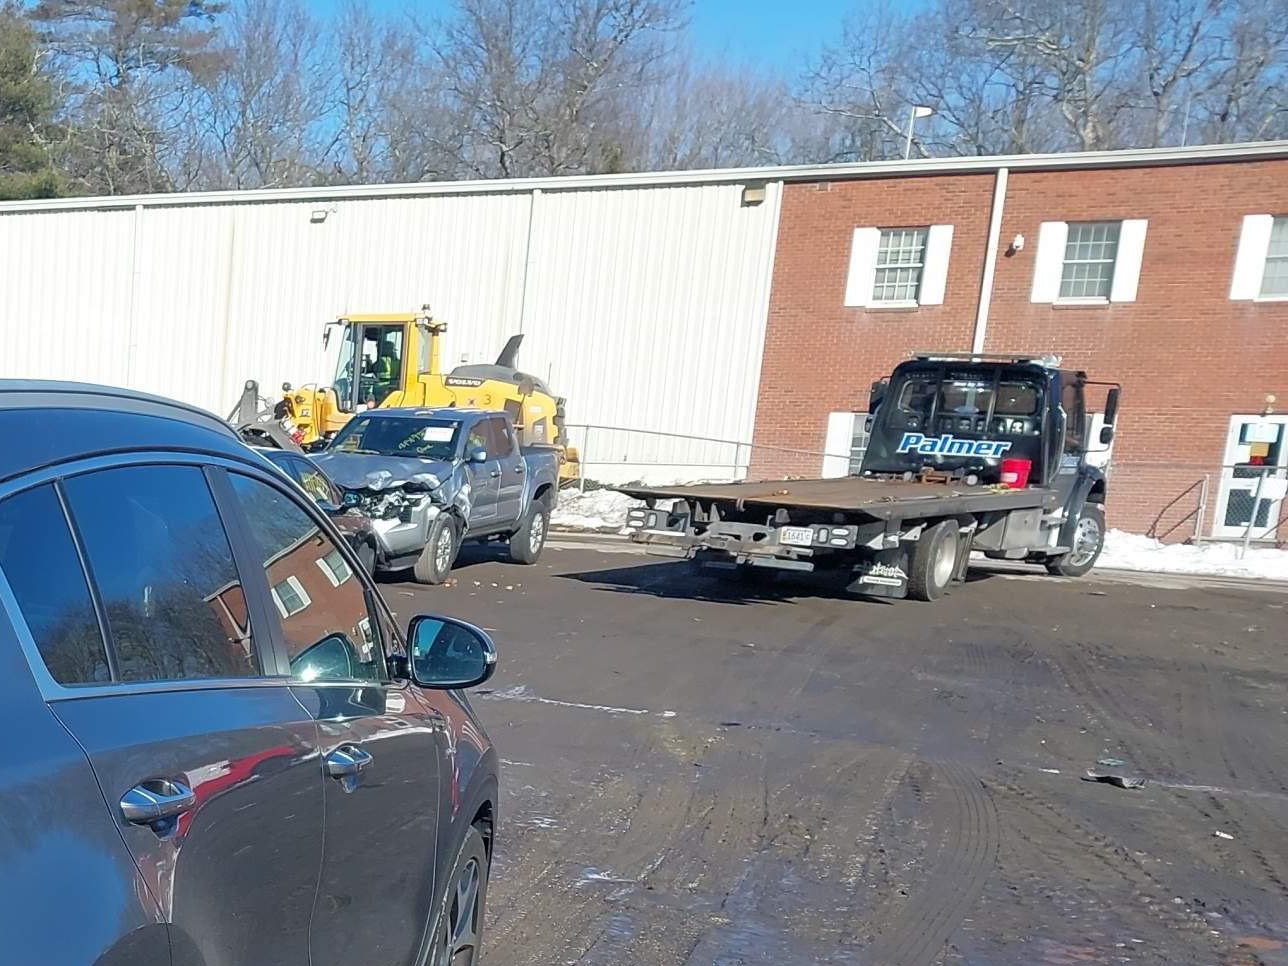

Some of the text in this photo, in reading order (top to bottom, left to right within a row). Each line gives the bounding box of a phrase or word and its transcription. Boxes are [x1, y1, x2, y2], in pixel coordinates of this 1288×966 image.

[447, 378, 482, 387] VOLVO
[483, 393, 492, 406] 3
[896, 432, 1012, 458] Palmer
